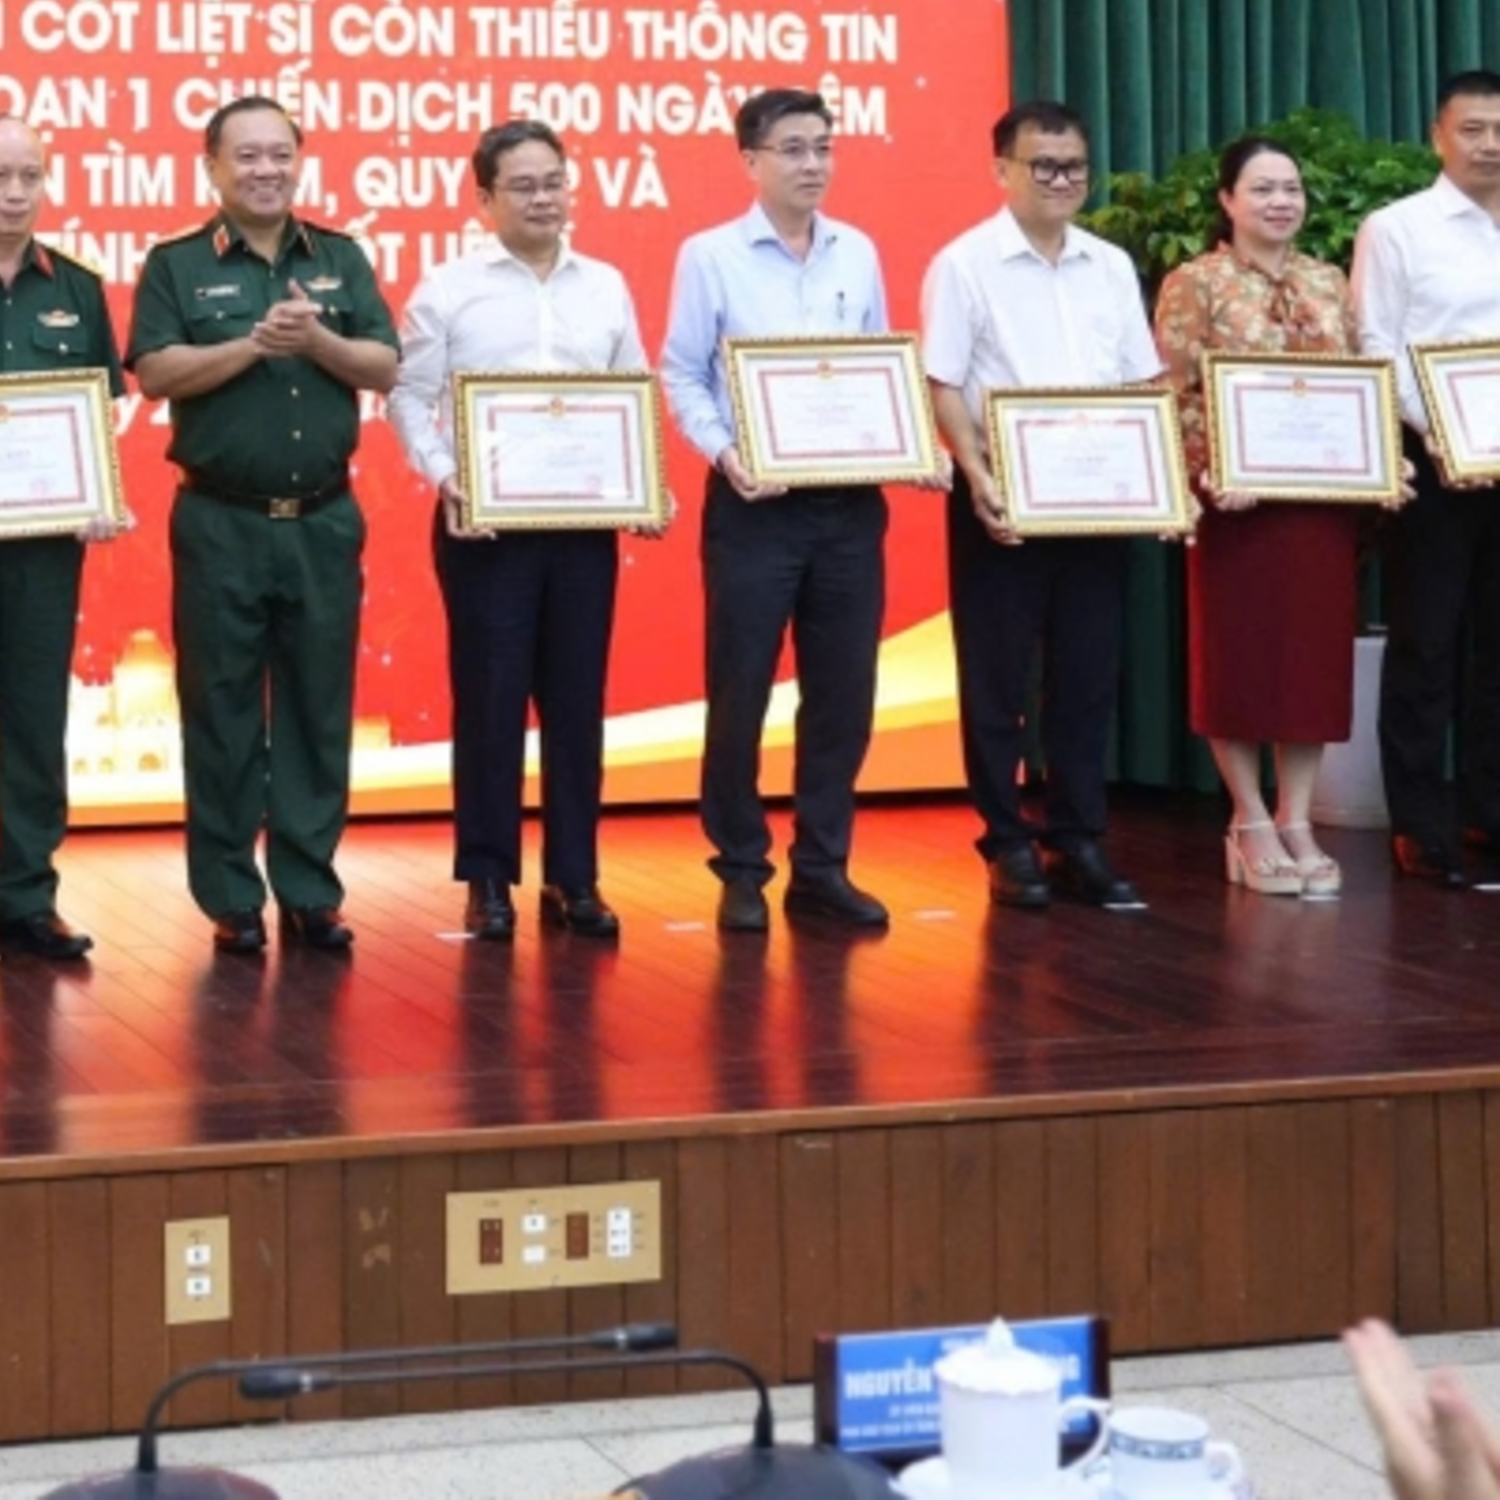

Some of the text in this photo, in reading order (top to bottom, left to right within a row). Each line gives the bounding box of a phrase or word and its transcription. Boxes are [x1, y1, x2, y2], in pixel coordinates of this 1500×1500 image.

[819, 12, 899, 64] TIN
[128, 77, 151, 133] 1
[356, 79, 494, 145] DỊCH
[508, 81, 603, 134] 500
[817, 71, 887, 136] ÊM
[80, 139, 175, 208] TÌM
[352, 155, 469, 210] QUY
[592, 142, 670, 209] VÀ
